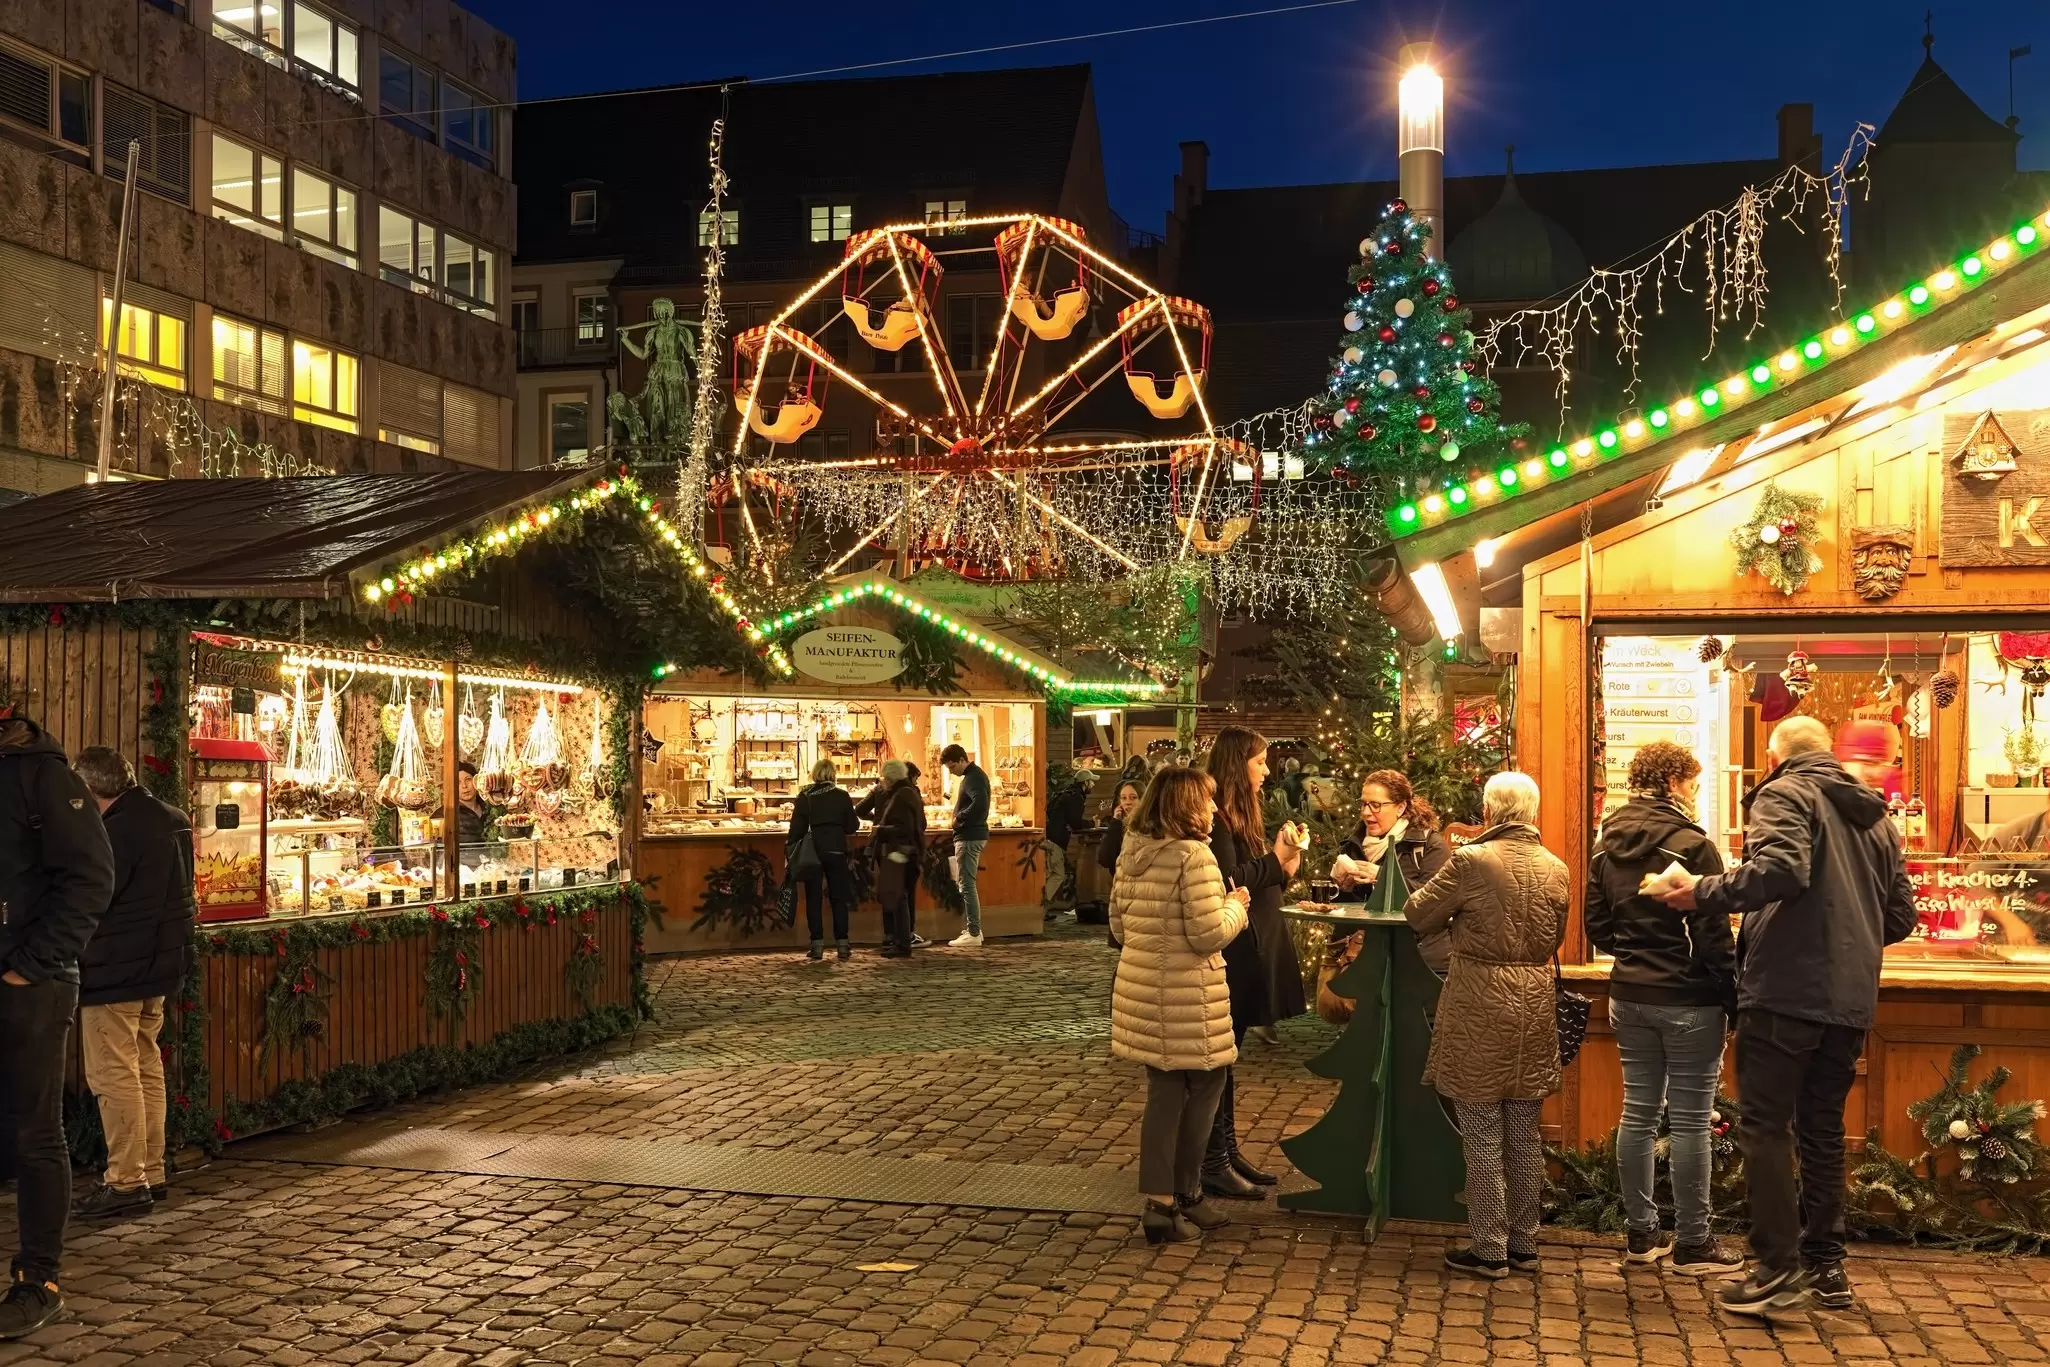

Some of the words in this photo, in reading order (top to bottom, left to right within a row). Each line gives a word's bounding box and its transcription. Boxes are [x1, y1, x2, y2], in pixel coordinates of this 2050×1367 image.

[826, 632, 876, 644] SEIFEN-
[805, 647, 896, 659] MANUFAKTUR
[204, 652, 280, 684] Magenbrot
[1608, 681, 1630, 691] Rote
[1610, 707, 1669, 718] Kräuterwurst
[1937, 869, 2014, 888] Kracher
